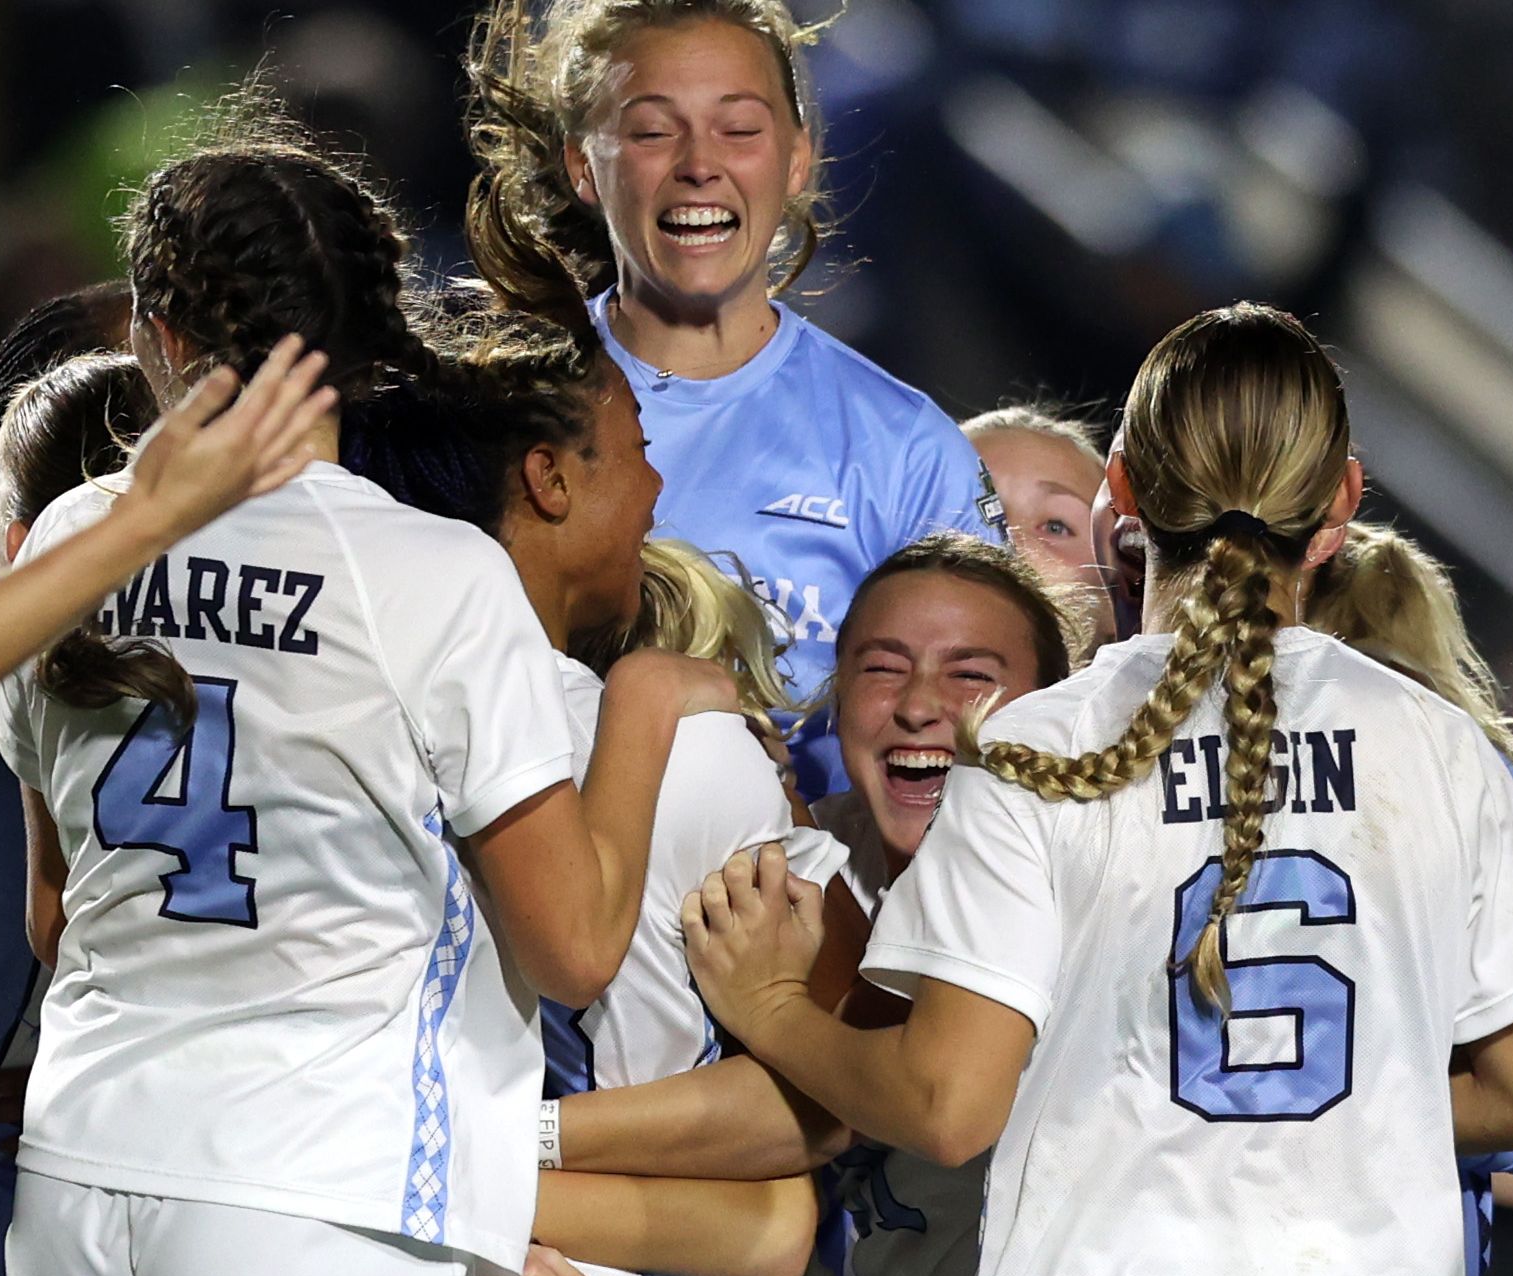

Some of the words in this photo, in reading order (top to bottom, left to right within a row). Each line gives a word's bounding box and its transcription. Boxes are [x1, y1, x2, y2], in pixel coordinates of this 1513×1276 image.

[766, 494, 849, 525] ACC
[97, 552, 326, 657] VAREZ
[91, 673, 259, 931] 4
[1159, 728, 1357, 824] ELGIN
[1168, 848, 1357, 1122] 6
